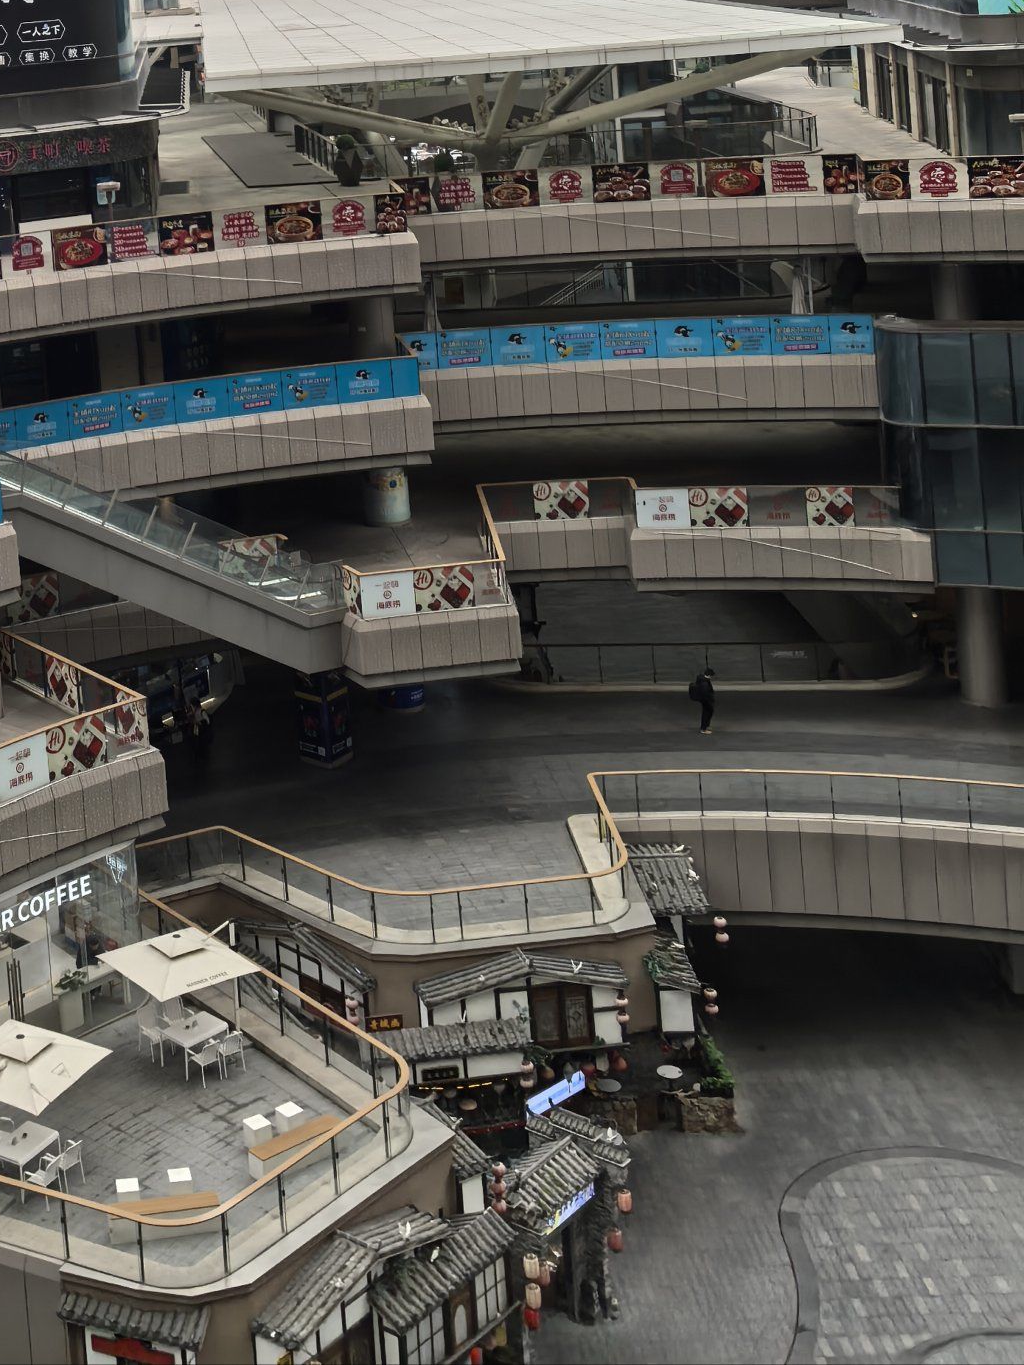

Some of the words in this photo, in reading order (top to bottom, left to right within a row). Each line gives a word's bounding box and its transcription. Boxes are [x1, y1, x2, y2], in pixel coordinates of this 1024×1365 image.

[22, 23, 61, 37] 一人之下
[25, 50, 50, 63] 集换
[68, 46, 93, 59] 教学
[376, 600, 401, 610] 海底捞
[9, 772, 33, 789] 海底捞
[18, 874, 92, 922] COFFEE
